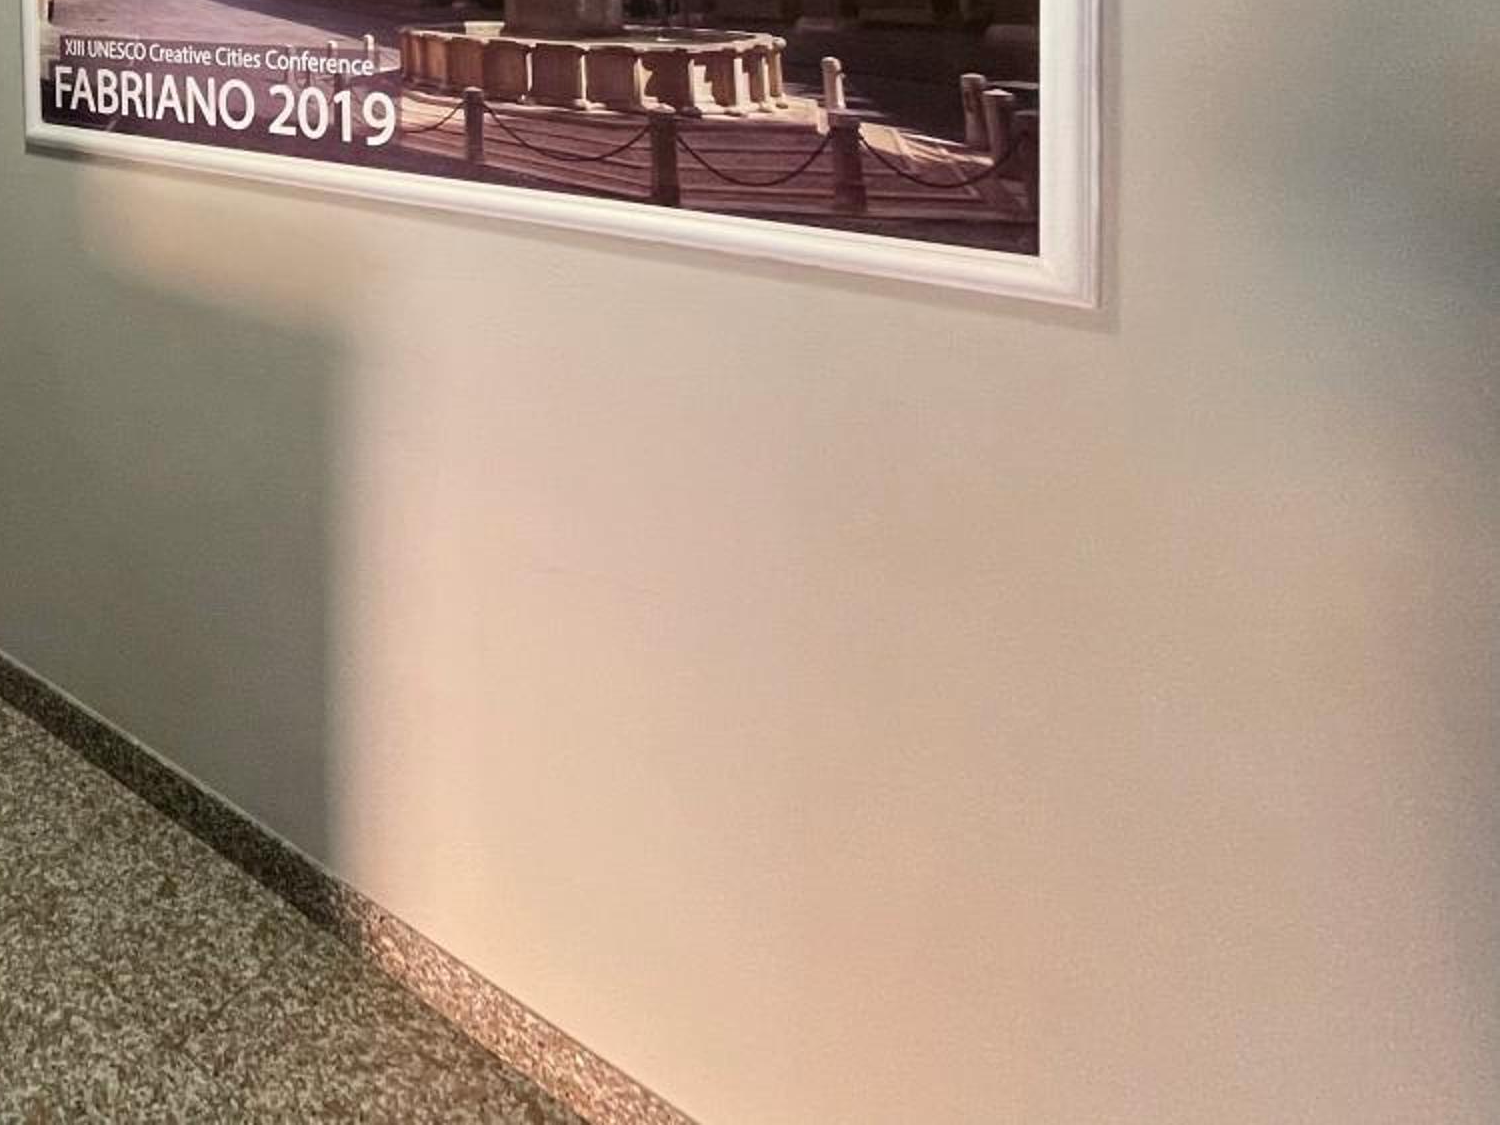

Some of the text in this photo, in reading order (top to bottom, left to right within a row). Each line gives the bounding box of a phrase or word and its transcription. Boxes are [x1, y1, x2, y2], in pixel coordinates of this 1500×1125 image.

[65, 39, 374, 76] XIII UNESCO Creative Cities Conference
[53, 66, 396, 146] FABRIANO 2019
